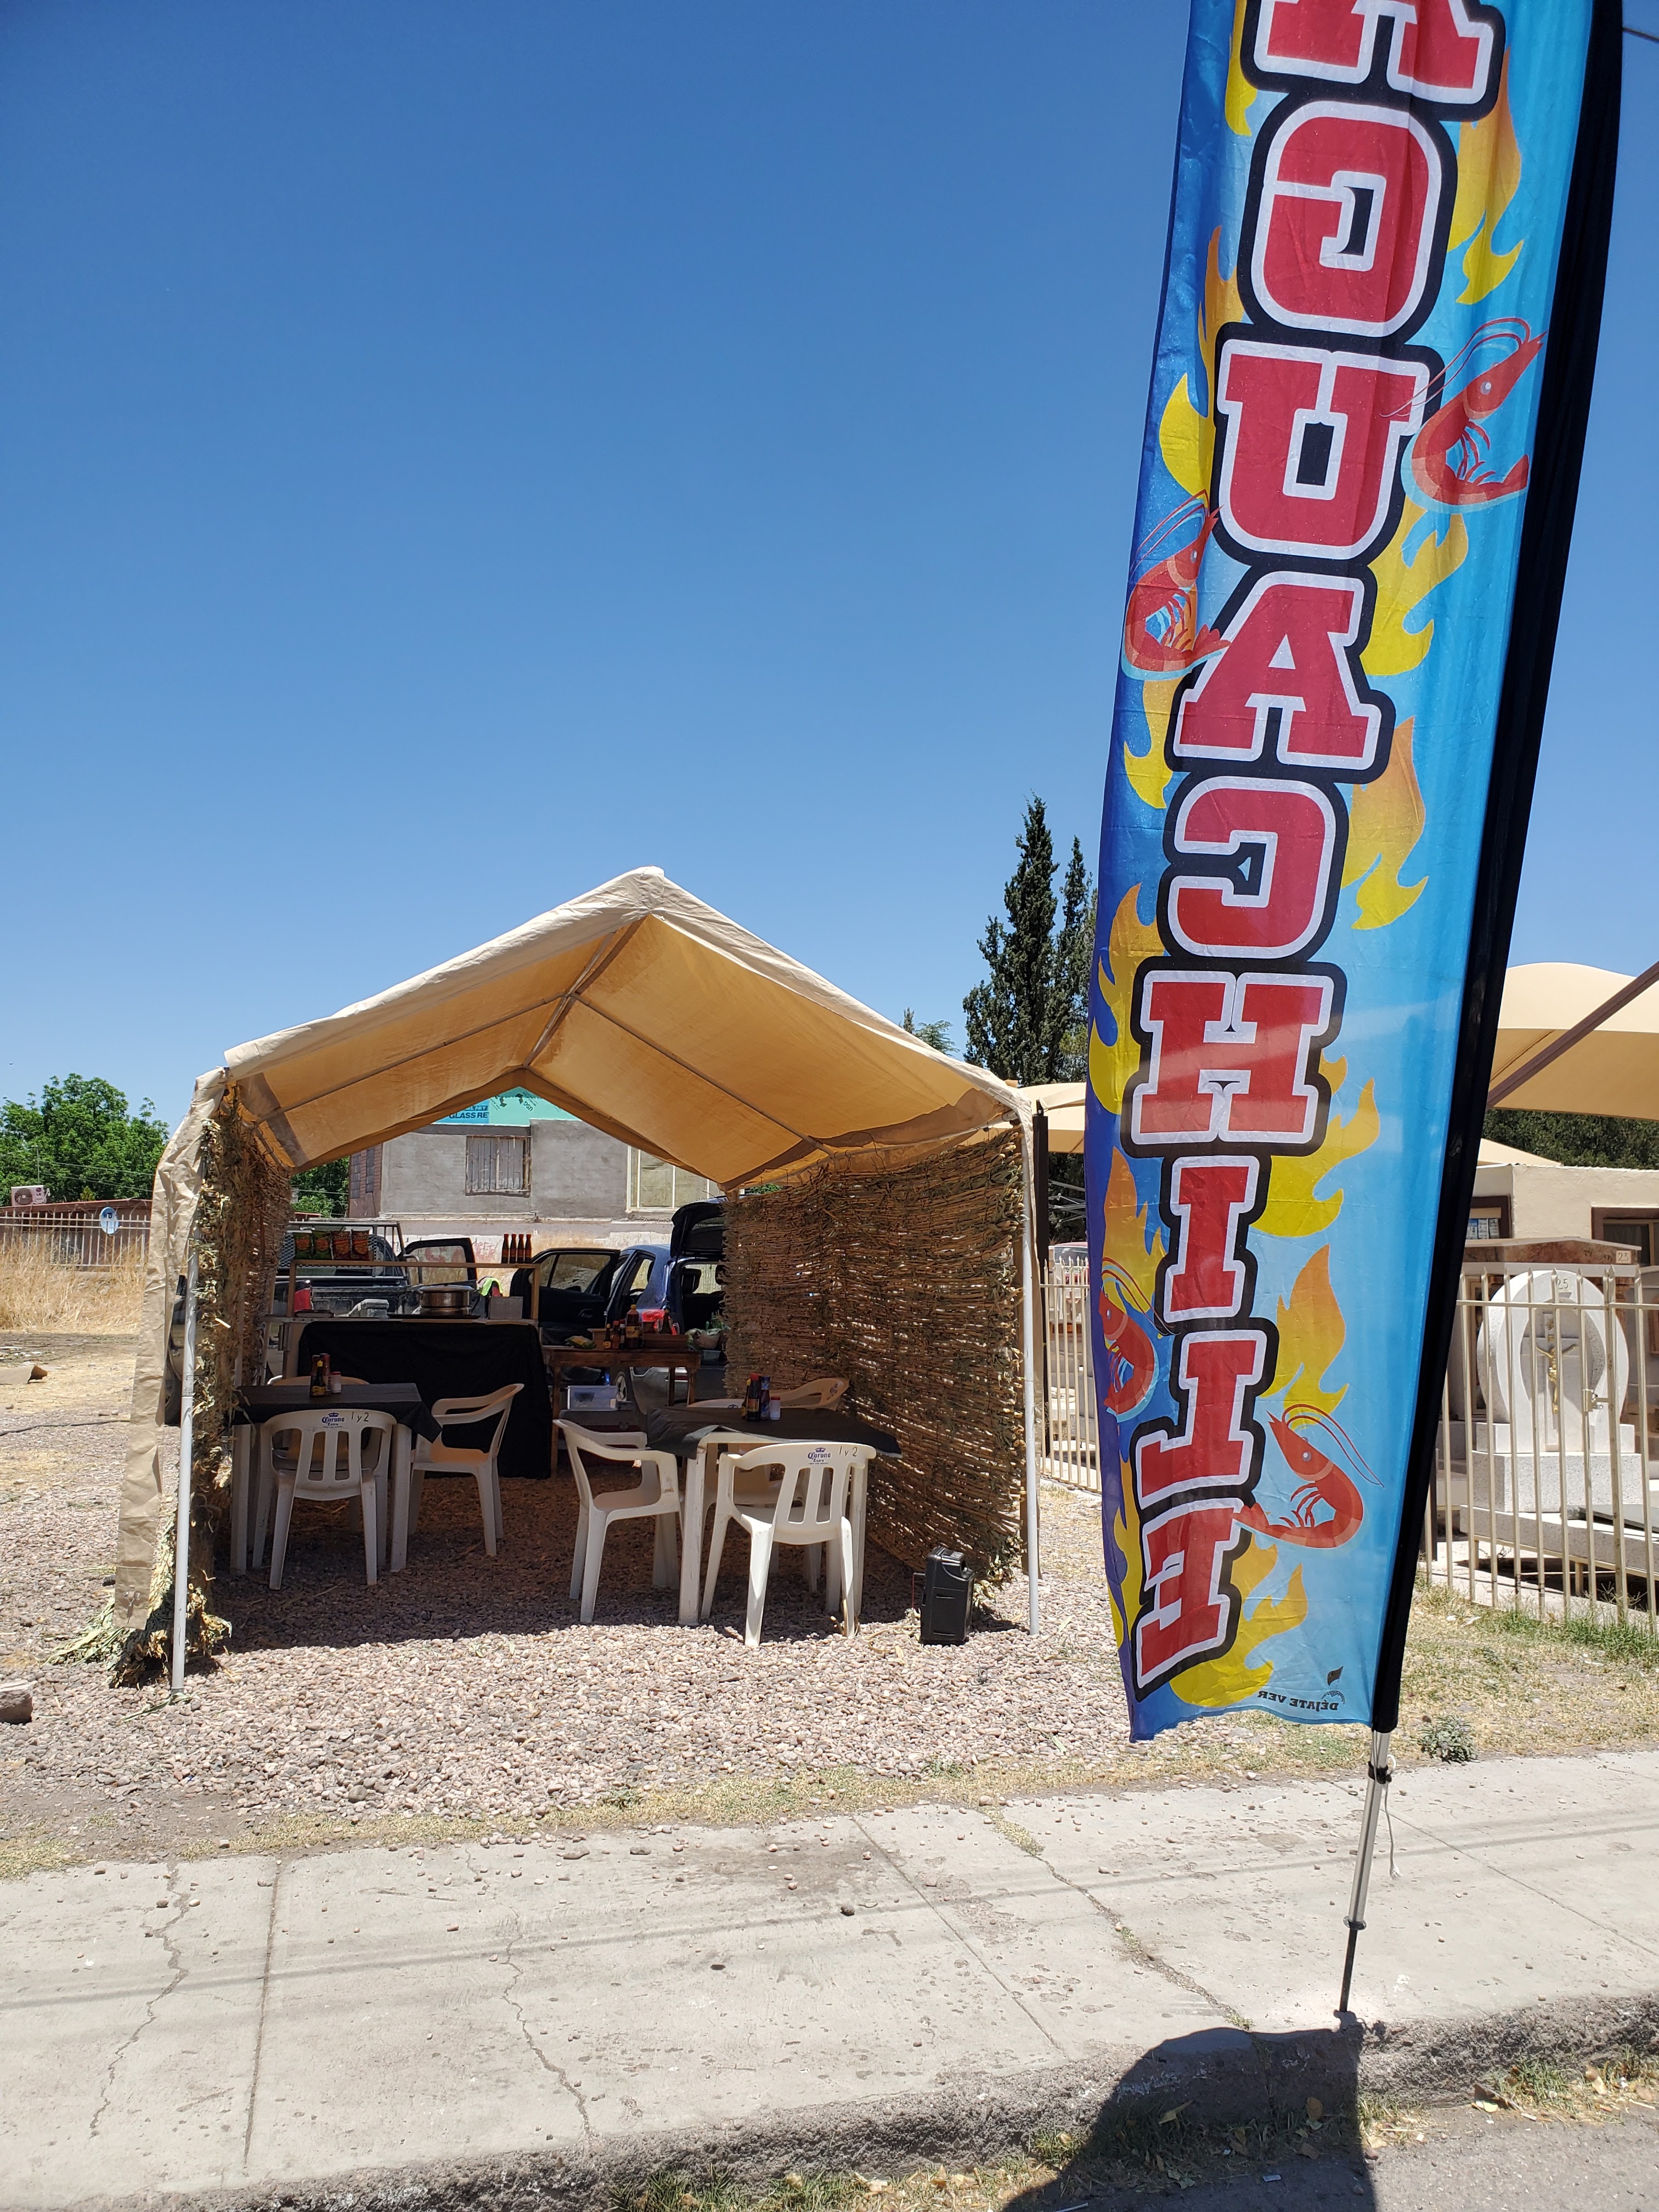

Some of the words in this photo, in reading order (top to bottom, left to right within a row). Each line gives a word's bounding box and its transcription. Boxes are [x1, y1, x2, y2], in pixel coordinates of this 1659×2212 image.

[523, 1101, 533, 1112] USG
[1618, 1252, 1629, 1261] 23
[1556, 1278, 1568, 1290] 25
[364, 1412, 369, 1422] 2
[852, 1446, 858, 1457] 2
